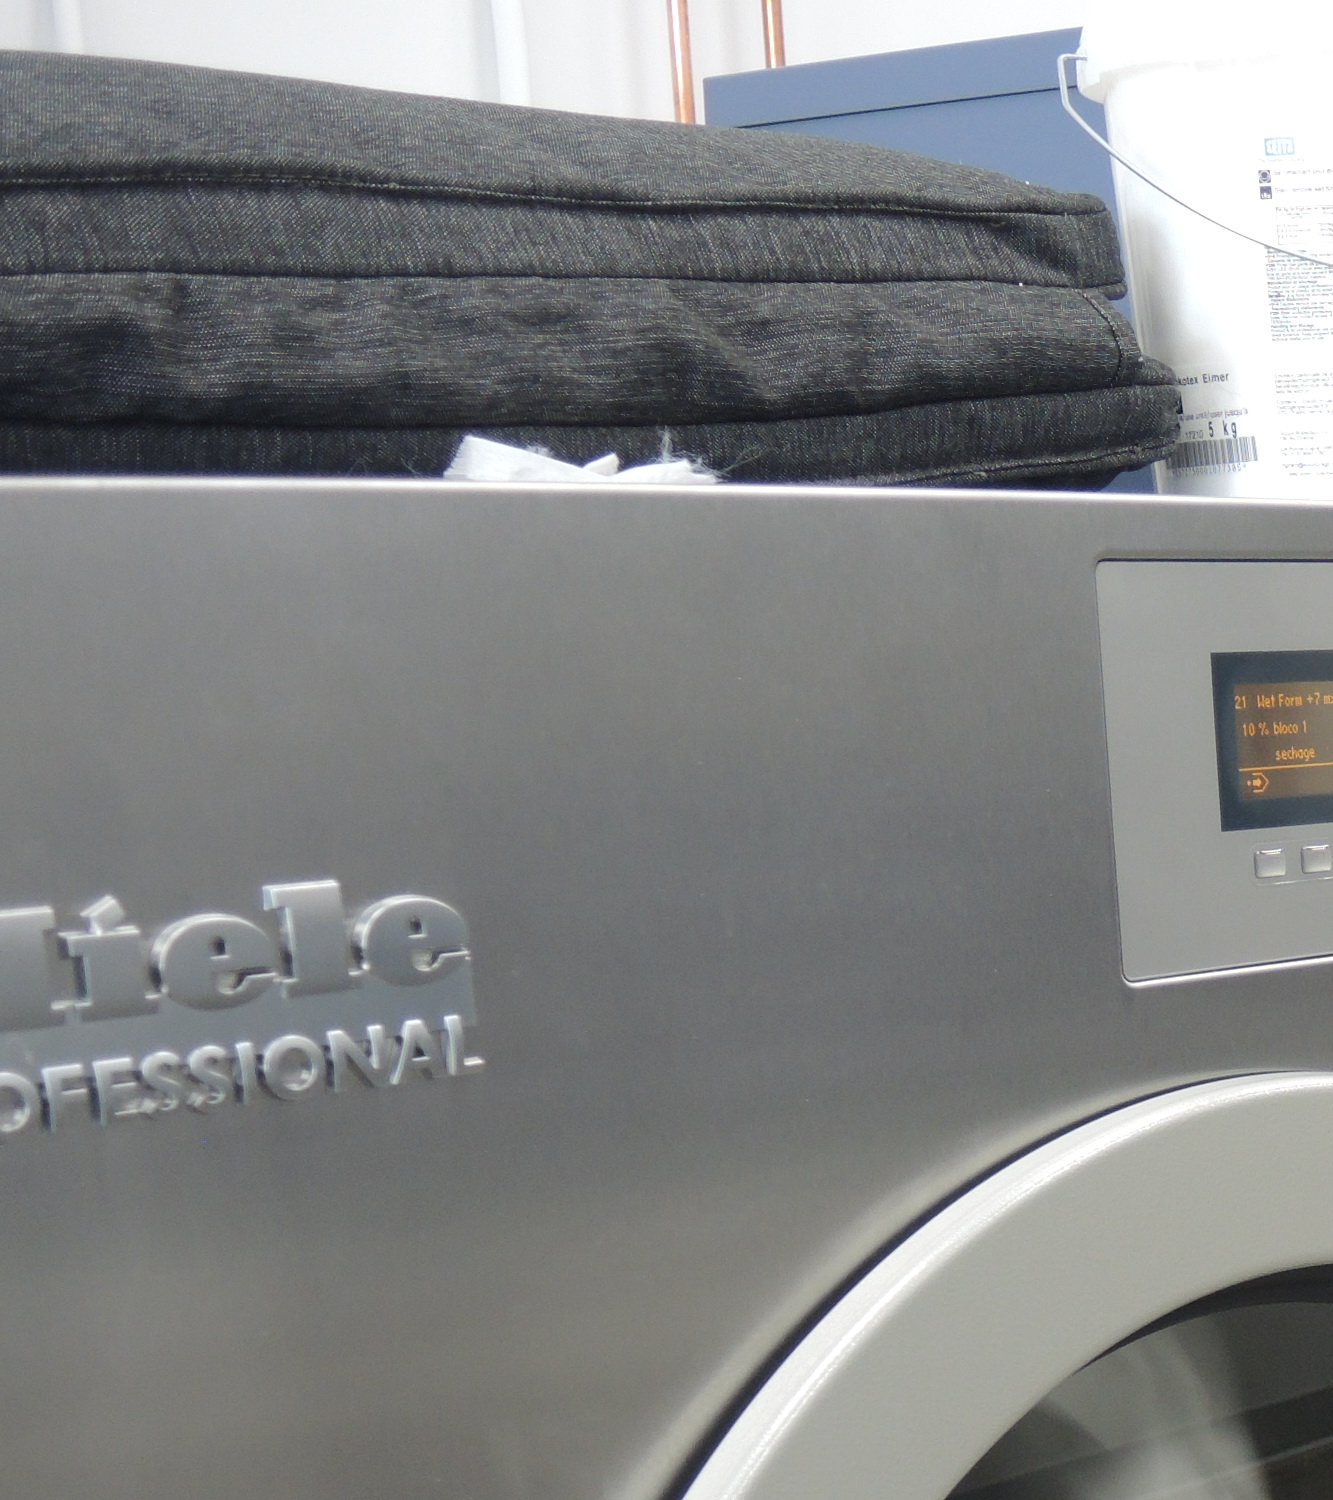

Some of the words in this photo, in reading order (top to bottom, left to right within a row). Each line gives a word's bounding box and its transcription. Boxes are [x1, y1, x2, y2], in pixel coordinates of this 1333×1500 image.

[1177, 376, 1199, 386] kotex
[1202, 373, 1229, 384] Eimer
[1208, 421, 1214, 437] 5
[1222, 420, 1237, 438] kg
[1233, 695, 1247, 710] 21
[1256, 693, 1276, 709] Wet
[1278, 692, 1303, 707] Form
[1242, 723, 1256, 737] 10
[1273, 721, 1299, 735] bloco
[1275, 745, 1316, 761] sechage
